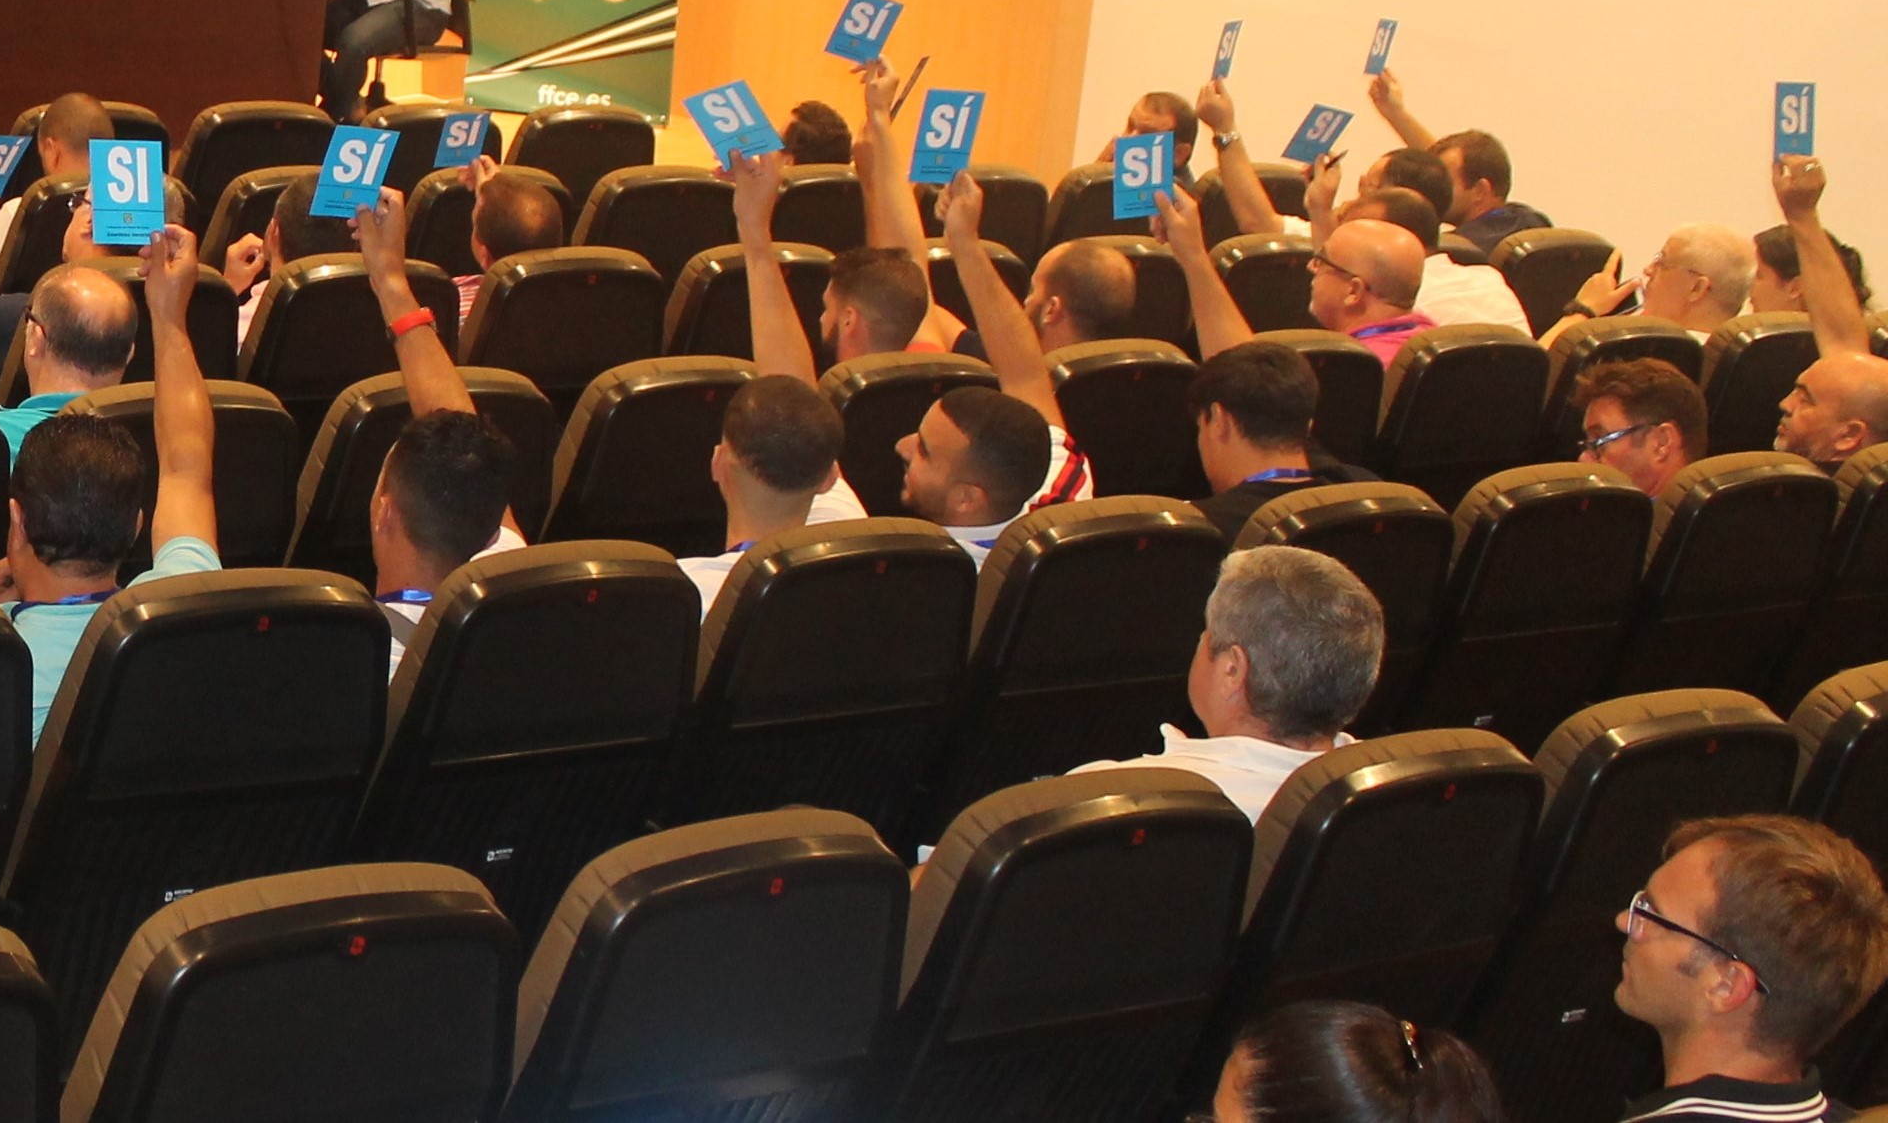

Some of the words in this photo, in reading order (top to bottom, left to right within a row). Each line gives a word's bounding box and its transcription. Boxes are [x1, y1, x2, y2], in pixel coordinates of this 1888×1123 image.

[844, 1, 894, 41] SÍ
[445, 114, 484, 149] SÍ
[924, 95, 975, 149] SÍ
[1779, 86, 1811, 135] SÍ
[107, 145, 149, 204] SI
[332, 132, 392, 186] SÍ
[1121, 134, 1165, 188] SÍ
